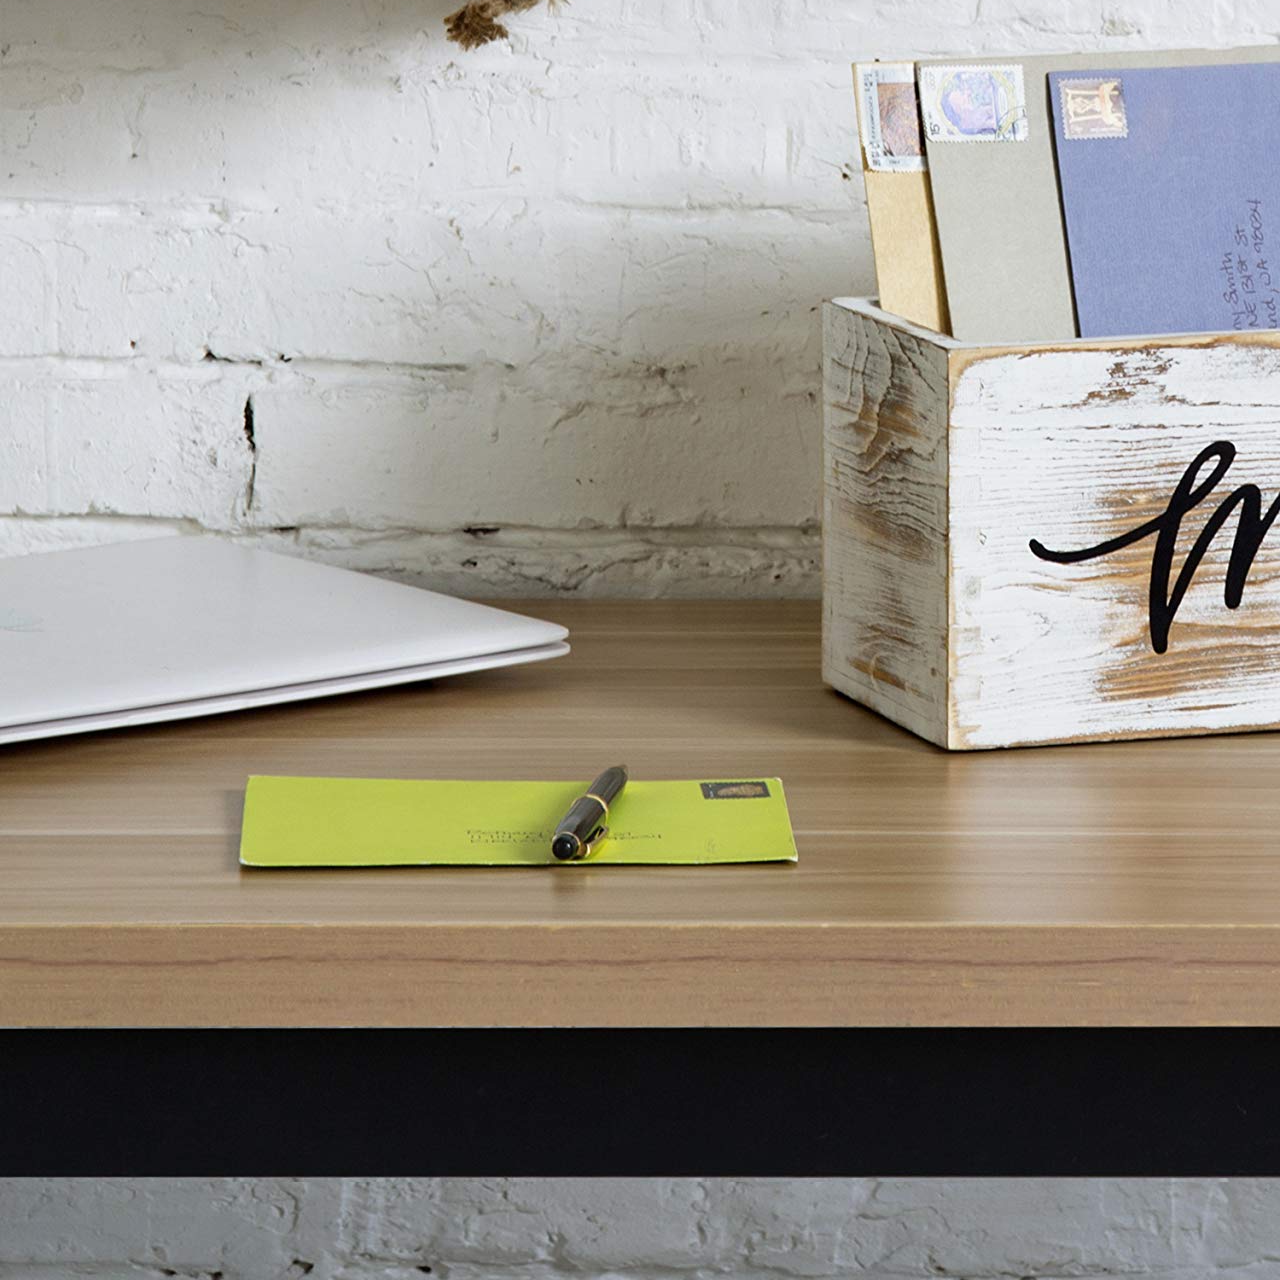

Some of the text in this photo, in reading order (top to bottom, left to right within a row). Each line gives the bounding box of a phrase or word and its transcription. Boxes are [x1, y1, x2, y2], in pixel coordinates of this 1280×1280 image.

[1234, 224, 1248, 247] St
[1219, 252, 1239, 305] Smith
[1256, 259, 1271, 286] WA
[1244, 300, 1259, 328] NE
